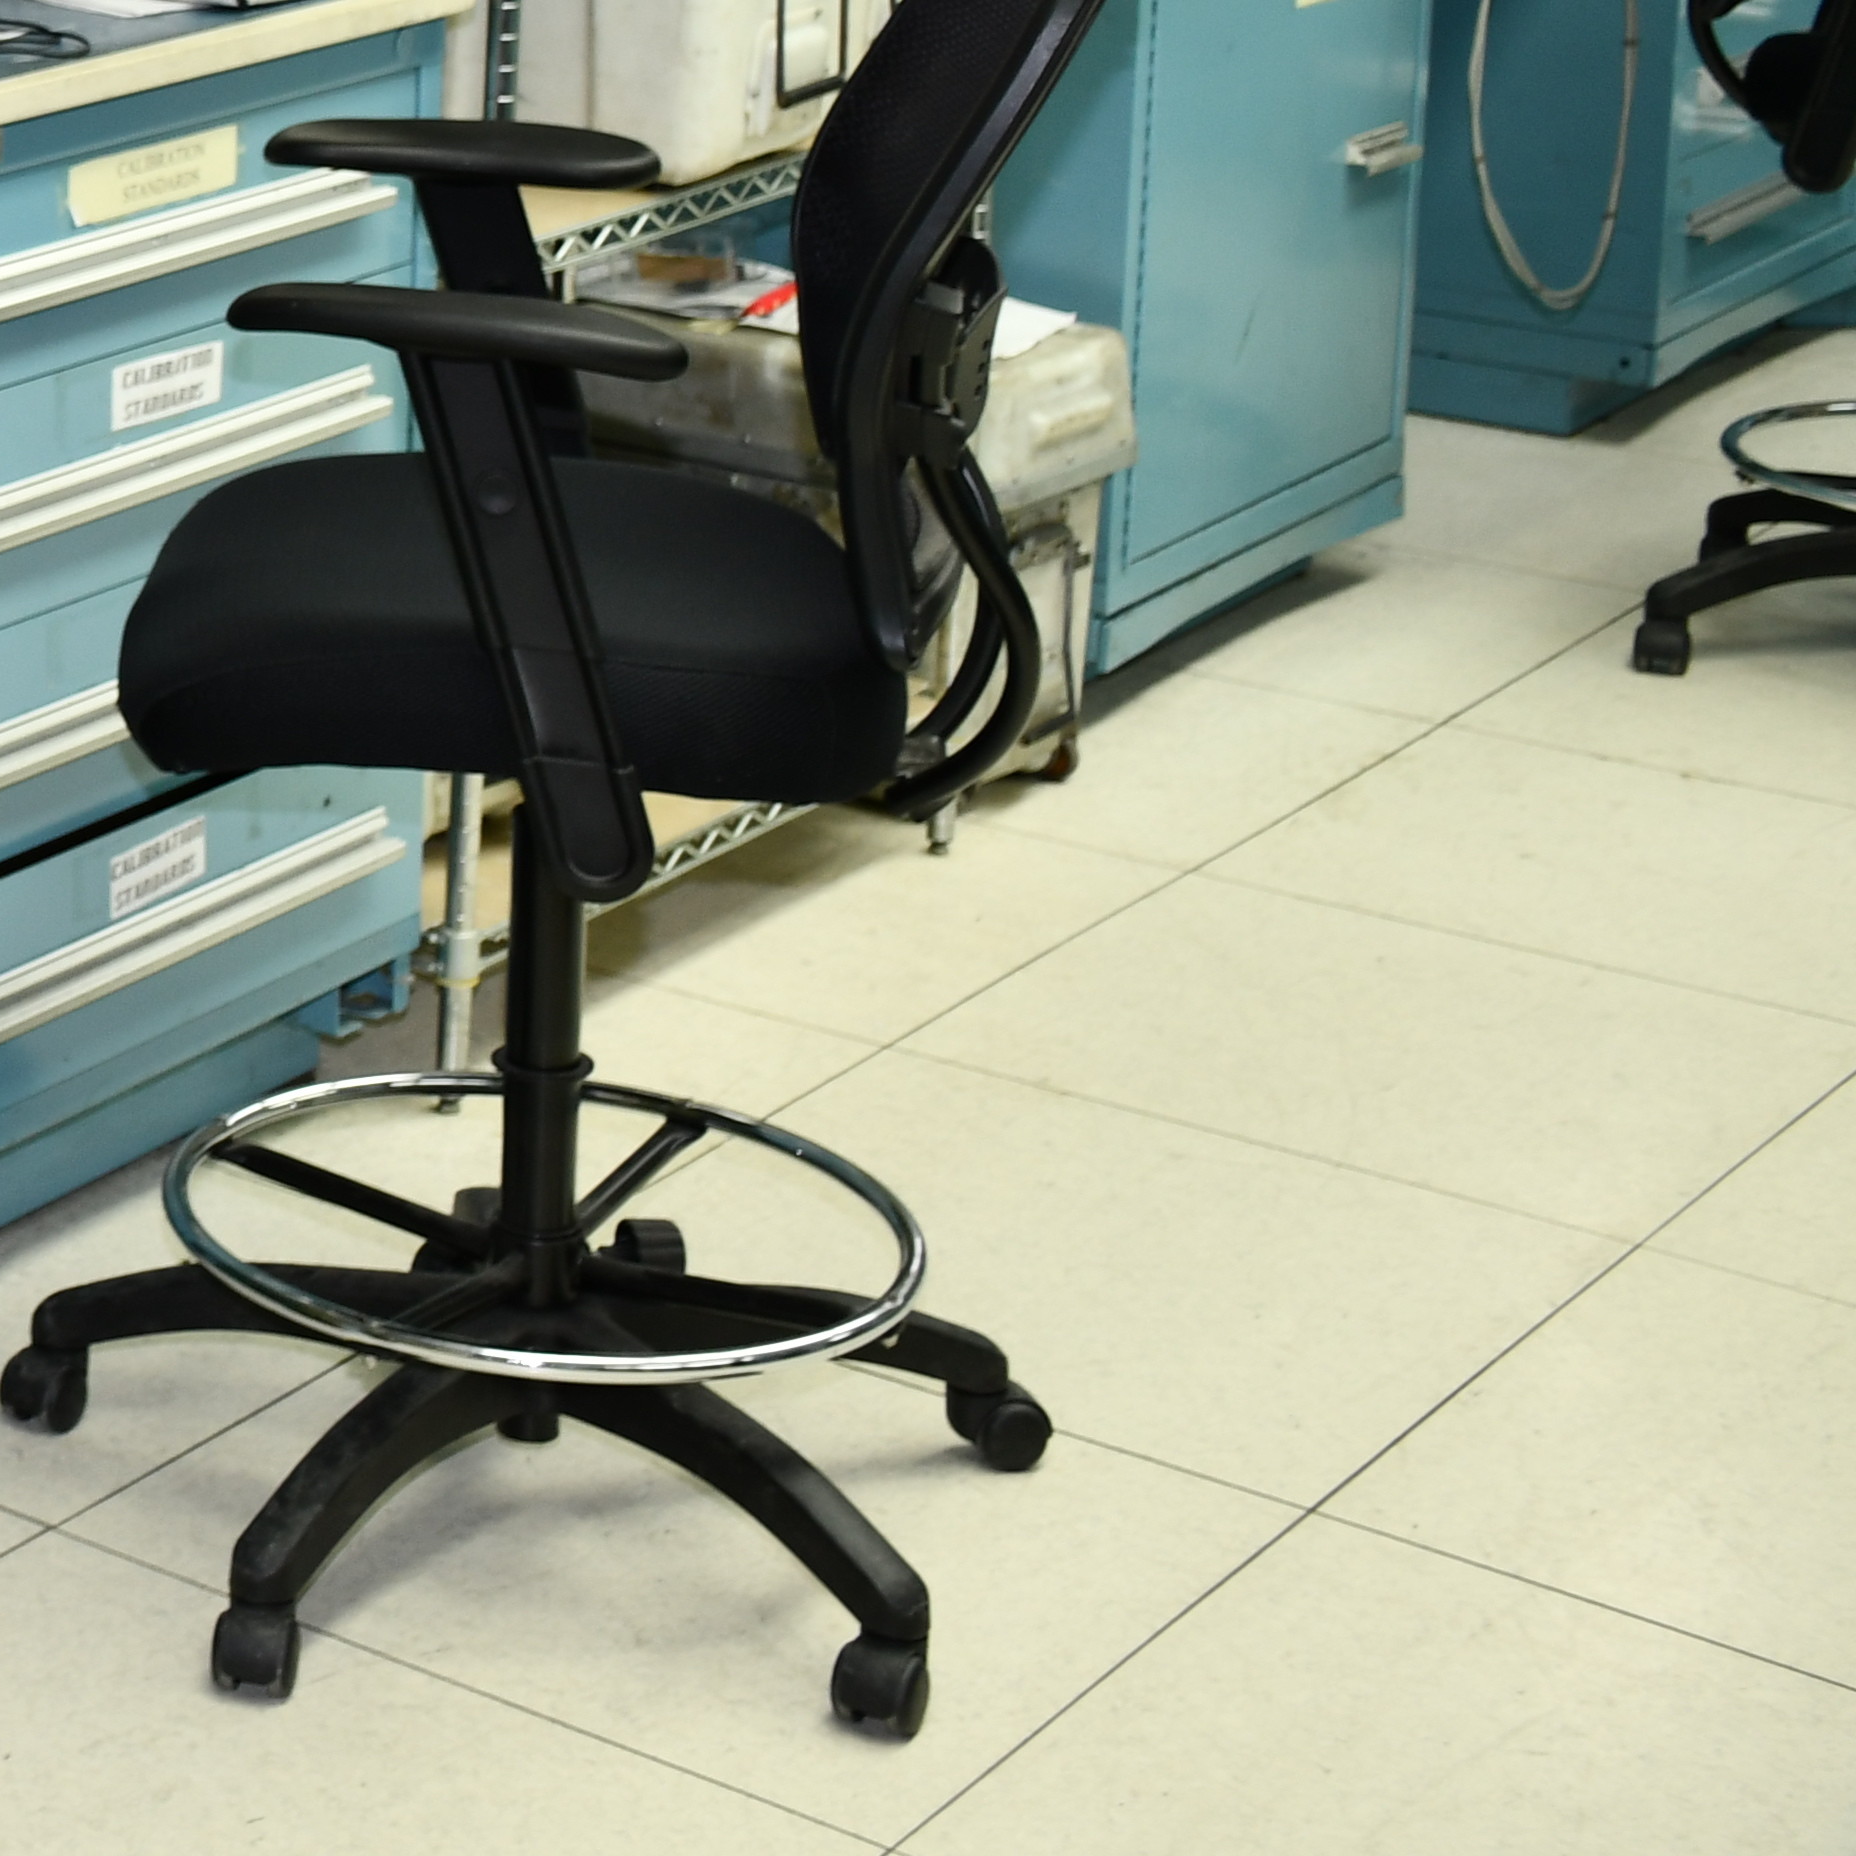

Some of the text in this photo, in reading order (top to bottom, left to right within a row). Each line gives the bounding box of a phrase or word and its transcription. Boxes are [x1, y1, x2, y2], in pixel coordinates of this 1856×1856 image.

[117, 143, 206, 180] CALIBRATION
[123, 168, 201, 205] STANDARDS
[121, 348, 214, 390] CALIBRATION
[124, 381, 206, 422] STANDARDS
[111, 821, 204, 882] CALIBRATION
[115, 853, 196, 912] STANDARDS
